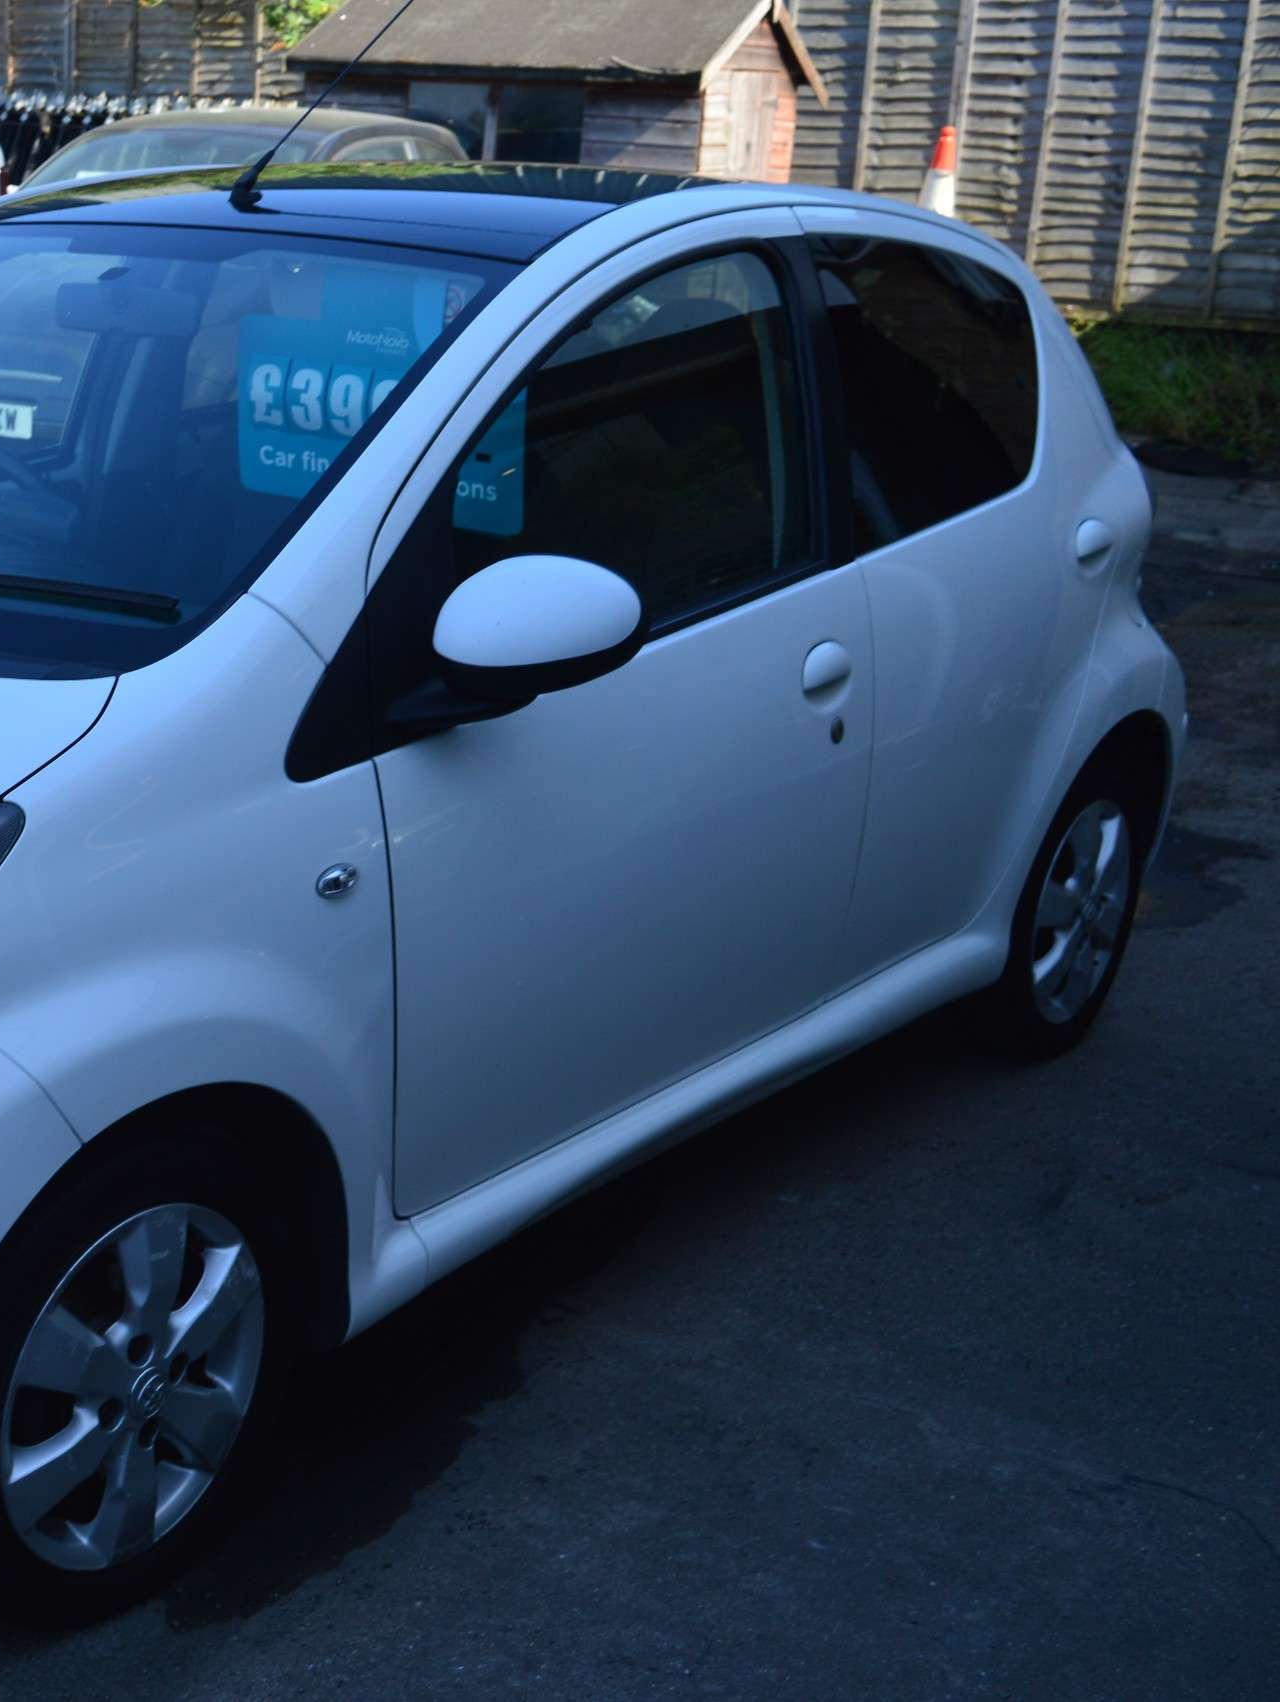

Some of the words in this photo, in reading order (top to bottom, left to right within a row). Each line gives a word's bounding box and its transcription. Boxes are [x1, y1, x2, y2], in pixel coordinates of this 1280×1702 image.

[260, 446, 296, 469] Car
[302, 450, 331, 473] fin
[456, 479, 498, 501] ons
